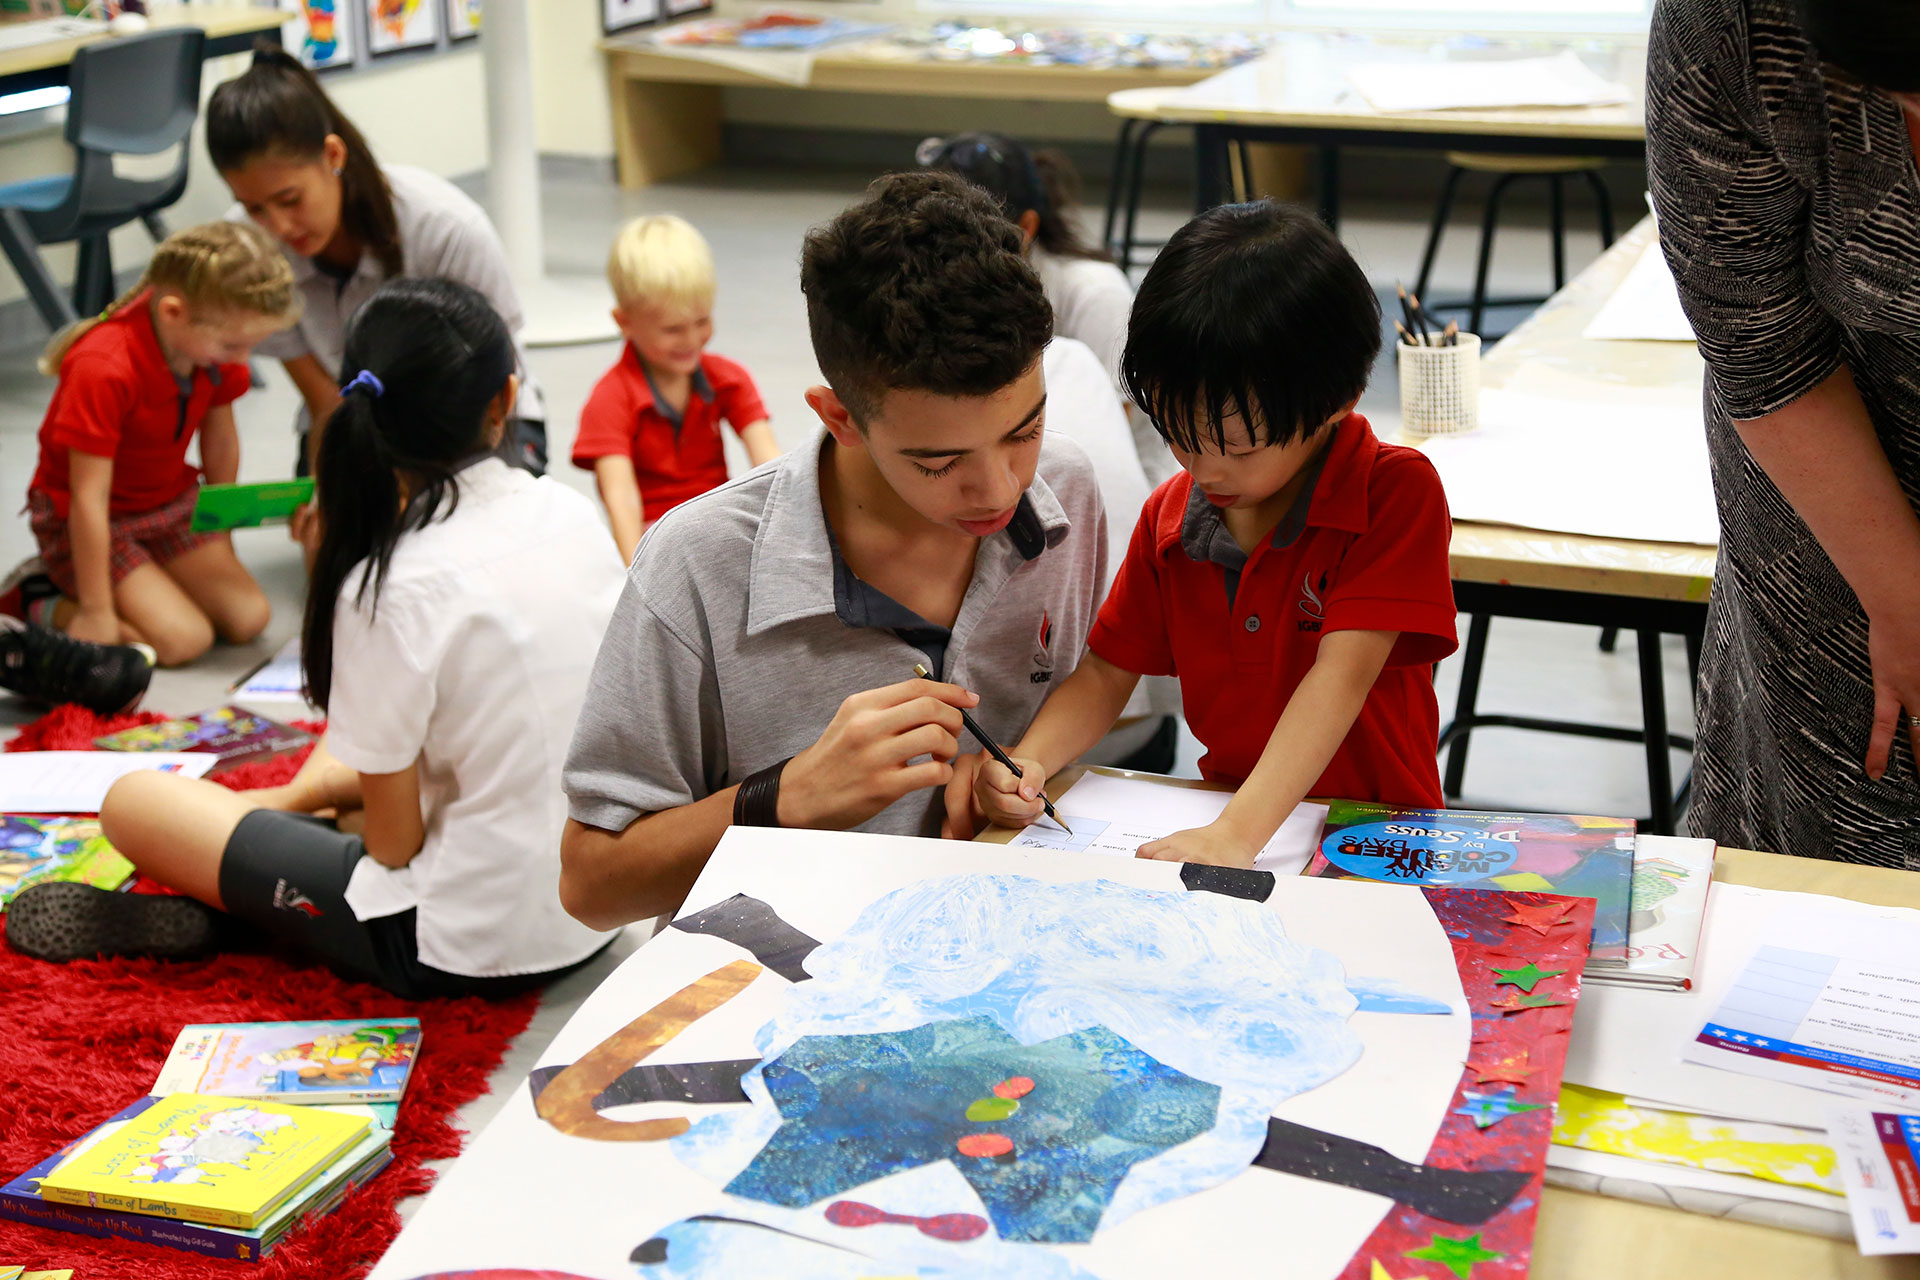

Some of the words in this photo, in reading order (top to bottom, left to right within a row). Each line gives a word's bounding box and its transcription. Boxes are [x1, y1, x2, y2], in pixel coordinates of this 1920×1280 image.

[1342, 835, 1408, 849] DAYS
[1383, 824, 1466, 844] Seuss
[1474, 830, 1521, 843] Dr.
[1463, 840, 1486, 849] by
[1385, 867, 1425, 879] MY
[91, 1152, 131, 1175] Lots
[102, 1194, 123, 1206] Lots
[126, 1199, 135, 1210] of
[138, 1198, 177, 1216] Lambs
[3, 1199, 17, 1213] My
[19, 1203, 53, 1220] Nursery
[55, 1209, 84, 1225] Rhyme
[121, 1220, 144, 1237] Book
